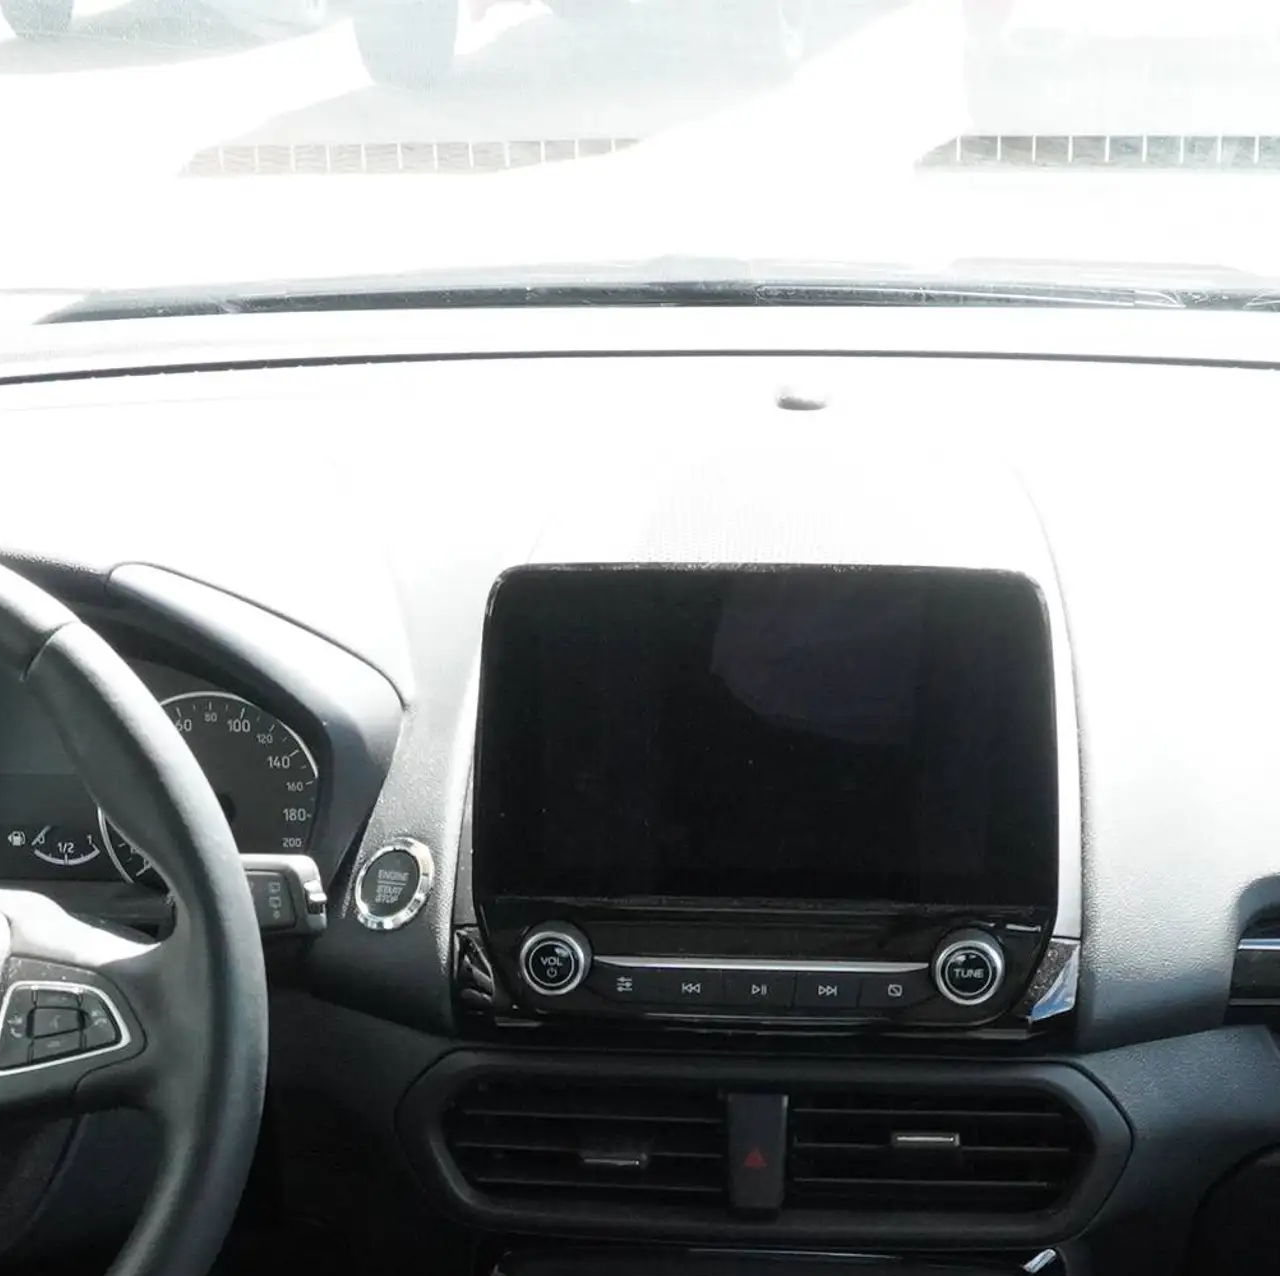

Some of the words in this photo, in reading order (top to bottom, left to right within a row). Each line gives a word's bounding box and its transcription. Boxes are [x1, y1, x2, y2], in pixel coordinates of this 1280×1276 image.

[204, 713, 217, 722] 80
[175, 719, 192, 732] 60
[227, 719, 251, 732] 100
[256, 734, 273, 744] 120
[268, 756, 290, 769] 140
[286, 782, 303, 792] 160
[283, 808, 306, 821] 180
[58, 842, 75, 853] 1/2
[282, 838, 302, 848] 200
[540, 956, 564, 967] VOL
[954, 968, 984, 978] TUNE
